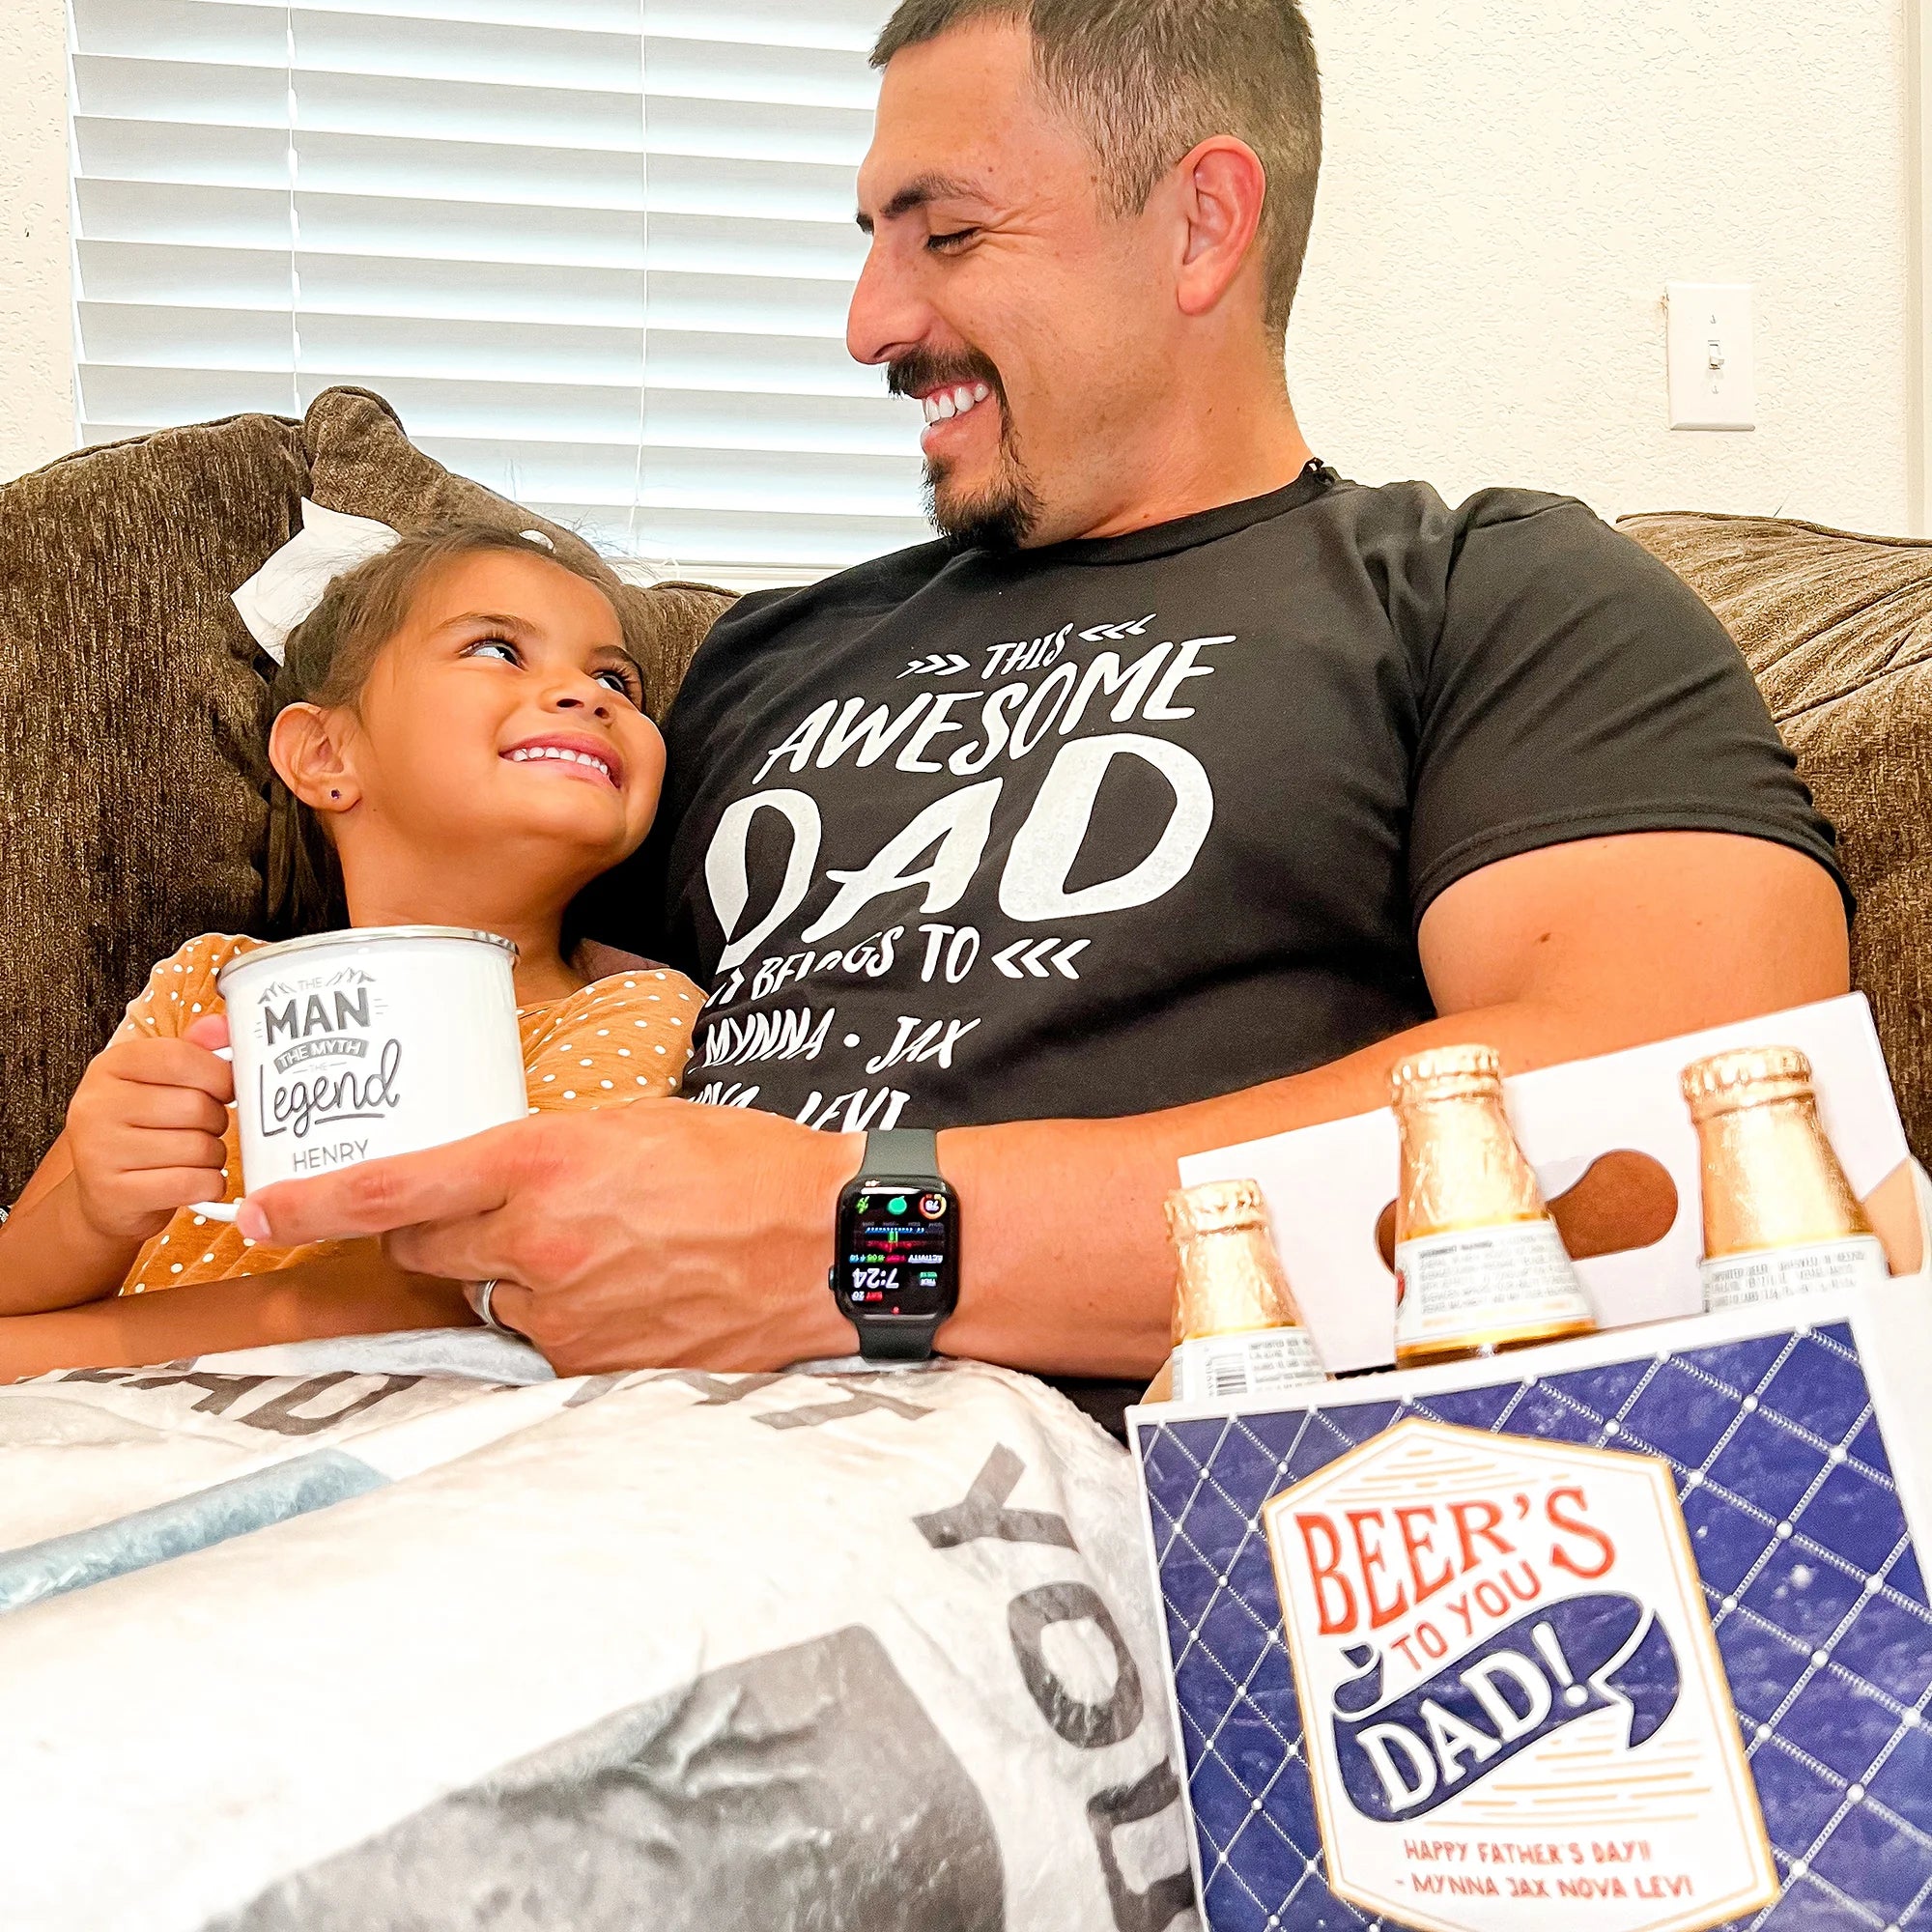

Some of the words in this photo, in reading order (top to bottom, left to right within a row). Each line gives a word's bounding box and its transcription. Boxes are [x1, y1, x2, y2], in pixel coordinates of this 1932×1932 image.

[981, 622, 1073, 680] THIS
[753, 635, 1236, 784] AWESOME
[705, 732, 1214, 969] DAD
[298, 978, 323, 990] THE
[751, 924, 903, 1001] BELGS
[919, 923, 980, 983] TO
[265, 987, 371, 1046] MAN
[689, 1007, 837, 1073] MYNNA
[866, 1016, 981, 1074] JAX
[278, 1047, 309, 1068] THE
[311, 1040, 361, 1057] MYTH
[260, 1038, 402, 1138] Legend
[293, 1139, 369, 1173] HENRY
[851, 1267, 899, 1290] 7:24
[1295, 1486, 1616, 1635] BEER'S
[1391, 1622, 1449, 1672] TO
[1445, 1559, 1541, 1637] YOU
[1356, 1620, 1589, 1812] DAD!
[1403, 1838, 1469, 1862] HAPPY
[1410, 1872, 1500, 1897] MYNNA
[1505, 1876, 1552, 1899] JAX
[1557, 1876, 1629, 1899] NOVA
[1634, 1874, 1695, 1900] LEVI
